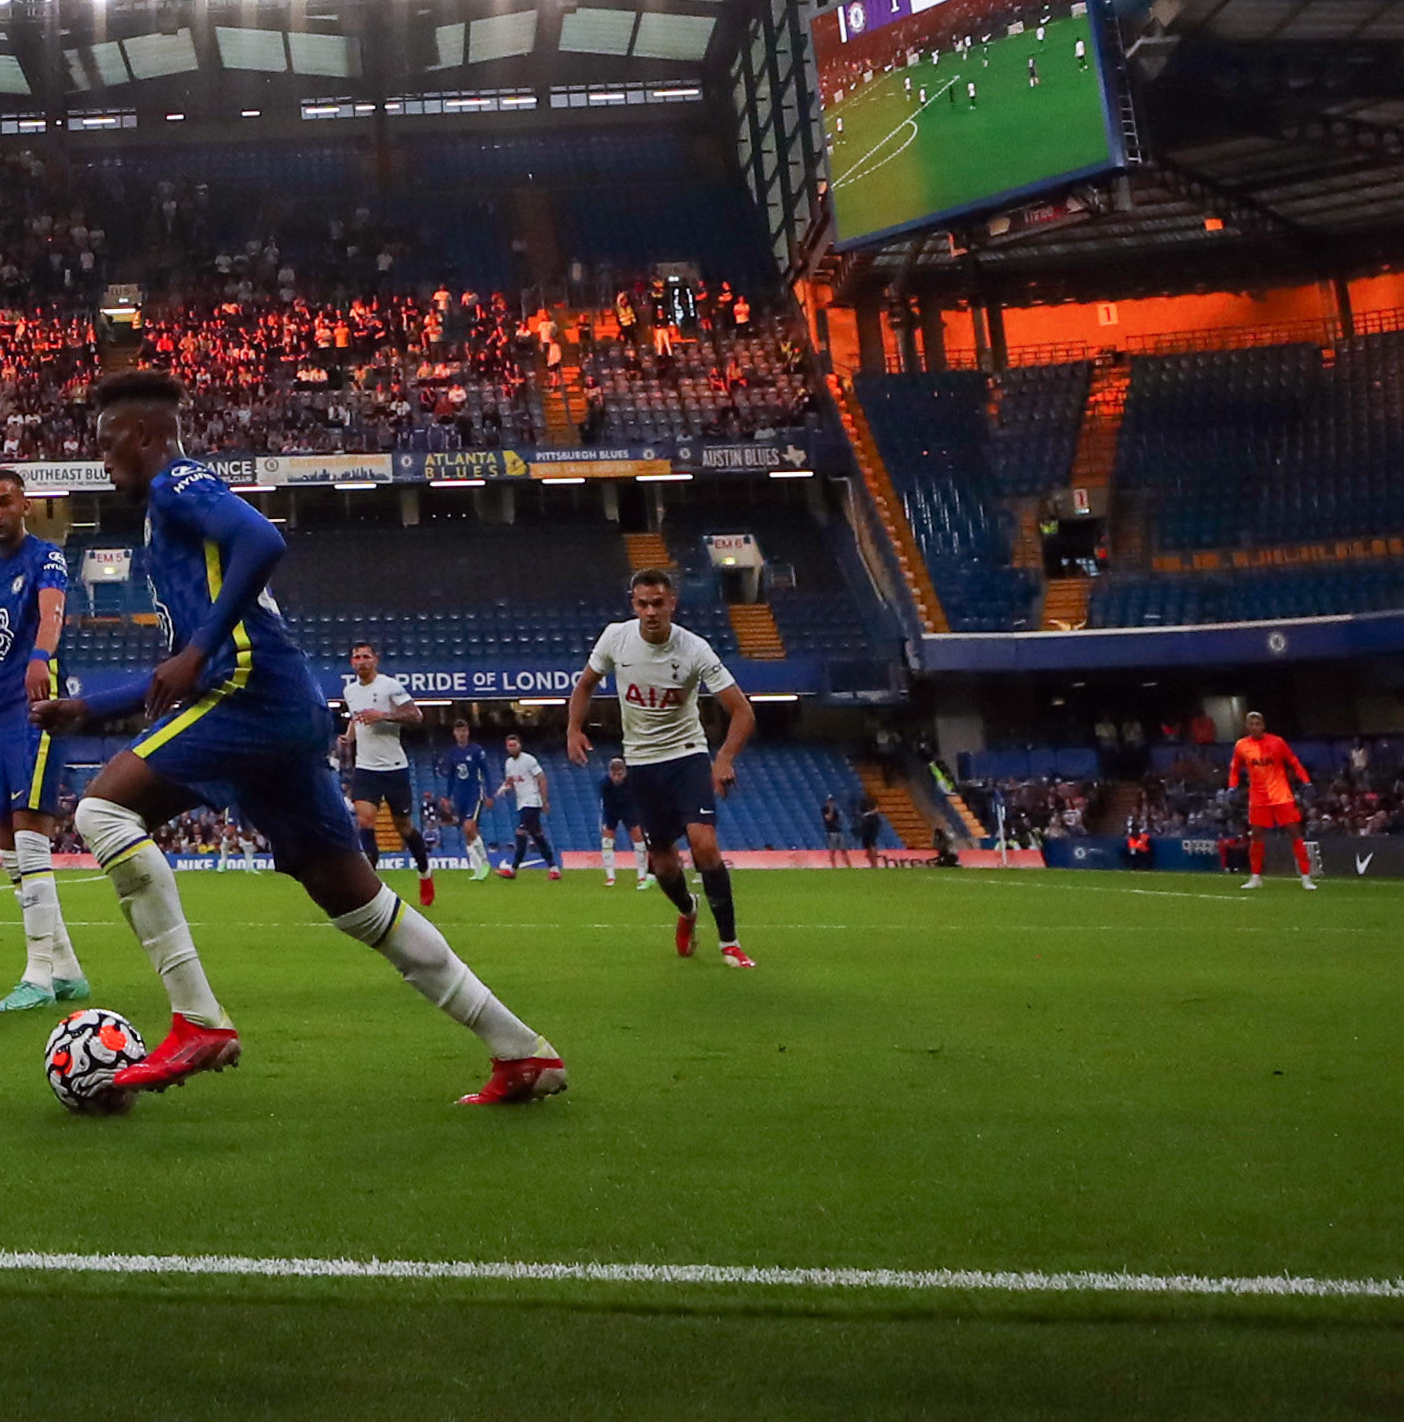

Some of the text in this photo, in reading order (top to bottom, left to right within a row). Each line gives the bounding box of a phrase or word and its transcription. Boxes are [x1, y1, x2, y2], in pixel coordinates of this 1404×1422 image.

[424, 452, 497, 467] ATLANTA
[536, 449, 629, 461] PITTSBURGH BLUES
[702, 447, 780, 468] AUSTIN BLUES
[85, 468, 108, 480] BLU
[207, 460, 253, 476] ANCE
[424, 465, 499, 479] BLUES
[96, 552, 123, 563] EM 5
[394, 672, 467, 691] PRIDE
[472, 672, 497, 685] OF
[625, 683, 682, 709] AIA
[176, 859, 214, 870] NIKE
